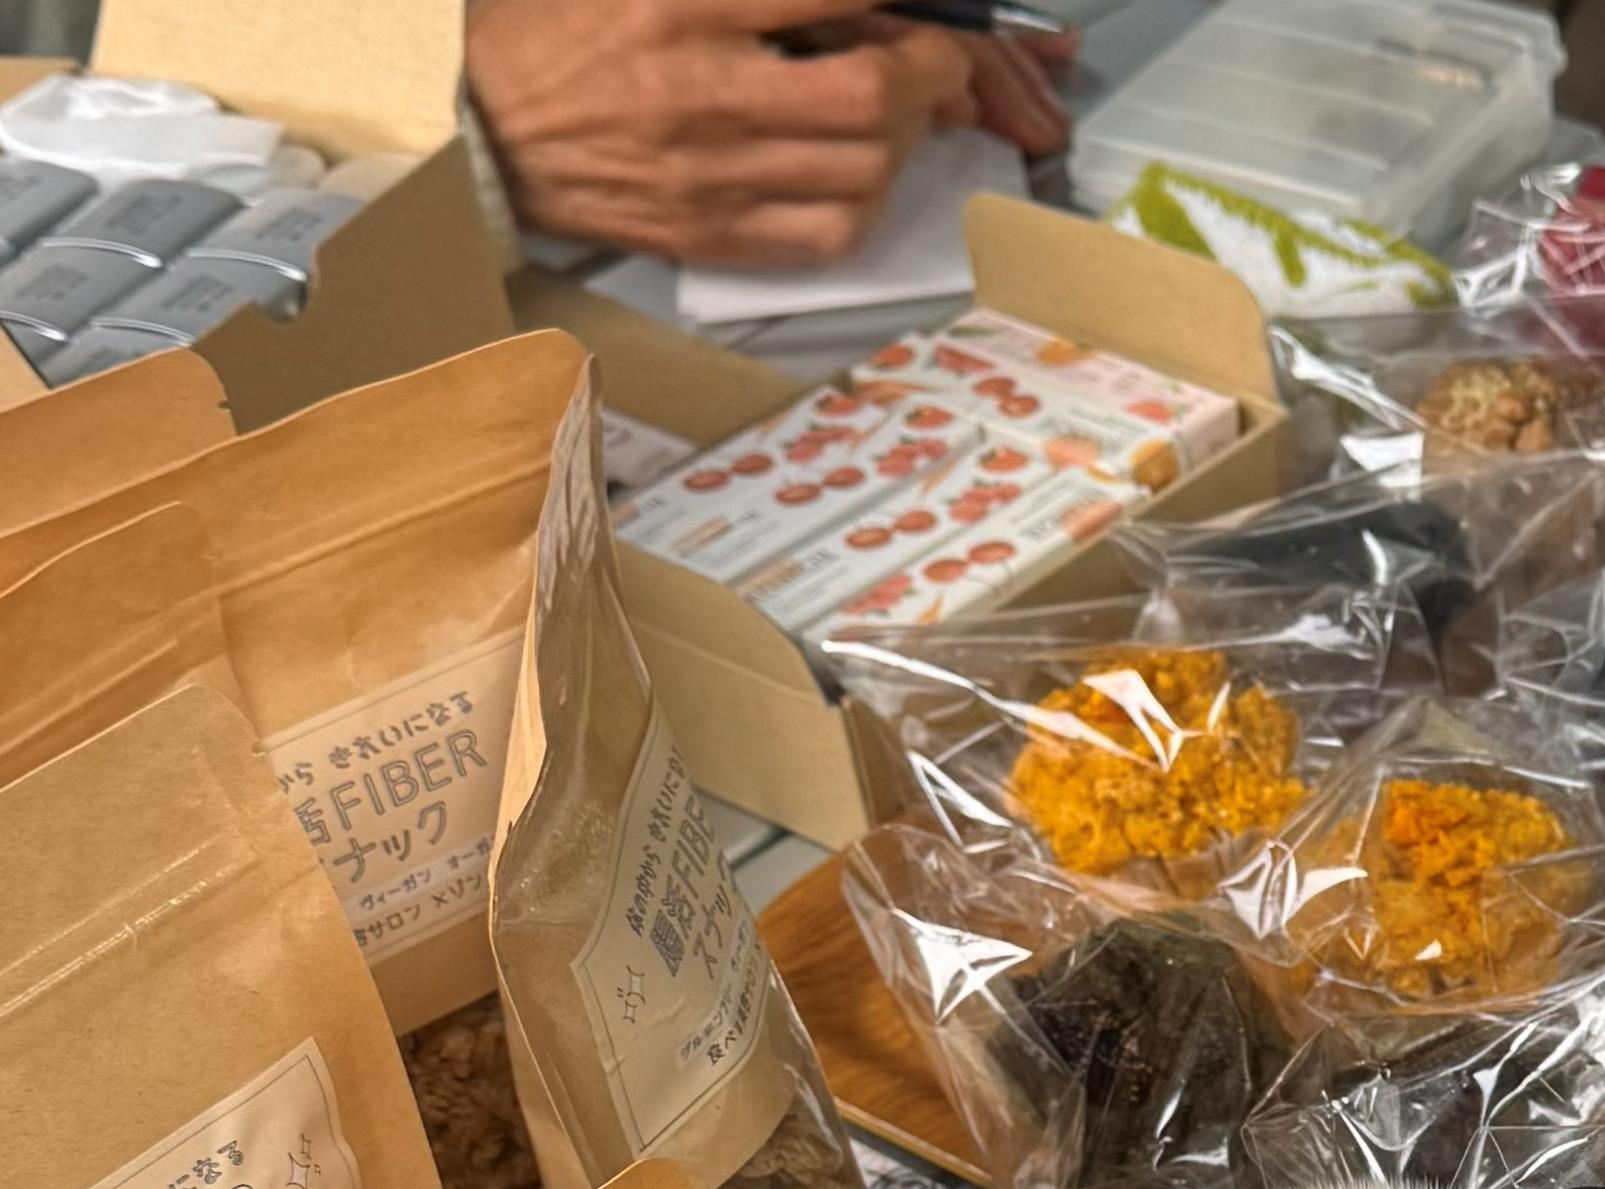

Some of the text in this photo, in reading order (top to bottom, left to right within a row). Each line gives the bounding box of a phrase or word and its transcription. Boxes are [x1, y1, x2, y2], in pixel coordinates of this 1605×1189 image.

[328, 690, 474, 770] きれいになる
[332, 801, 448, 884] ナック
[431, 872, 482, 909] メゾン
